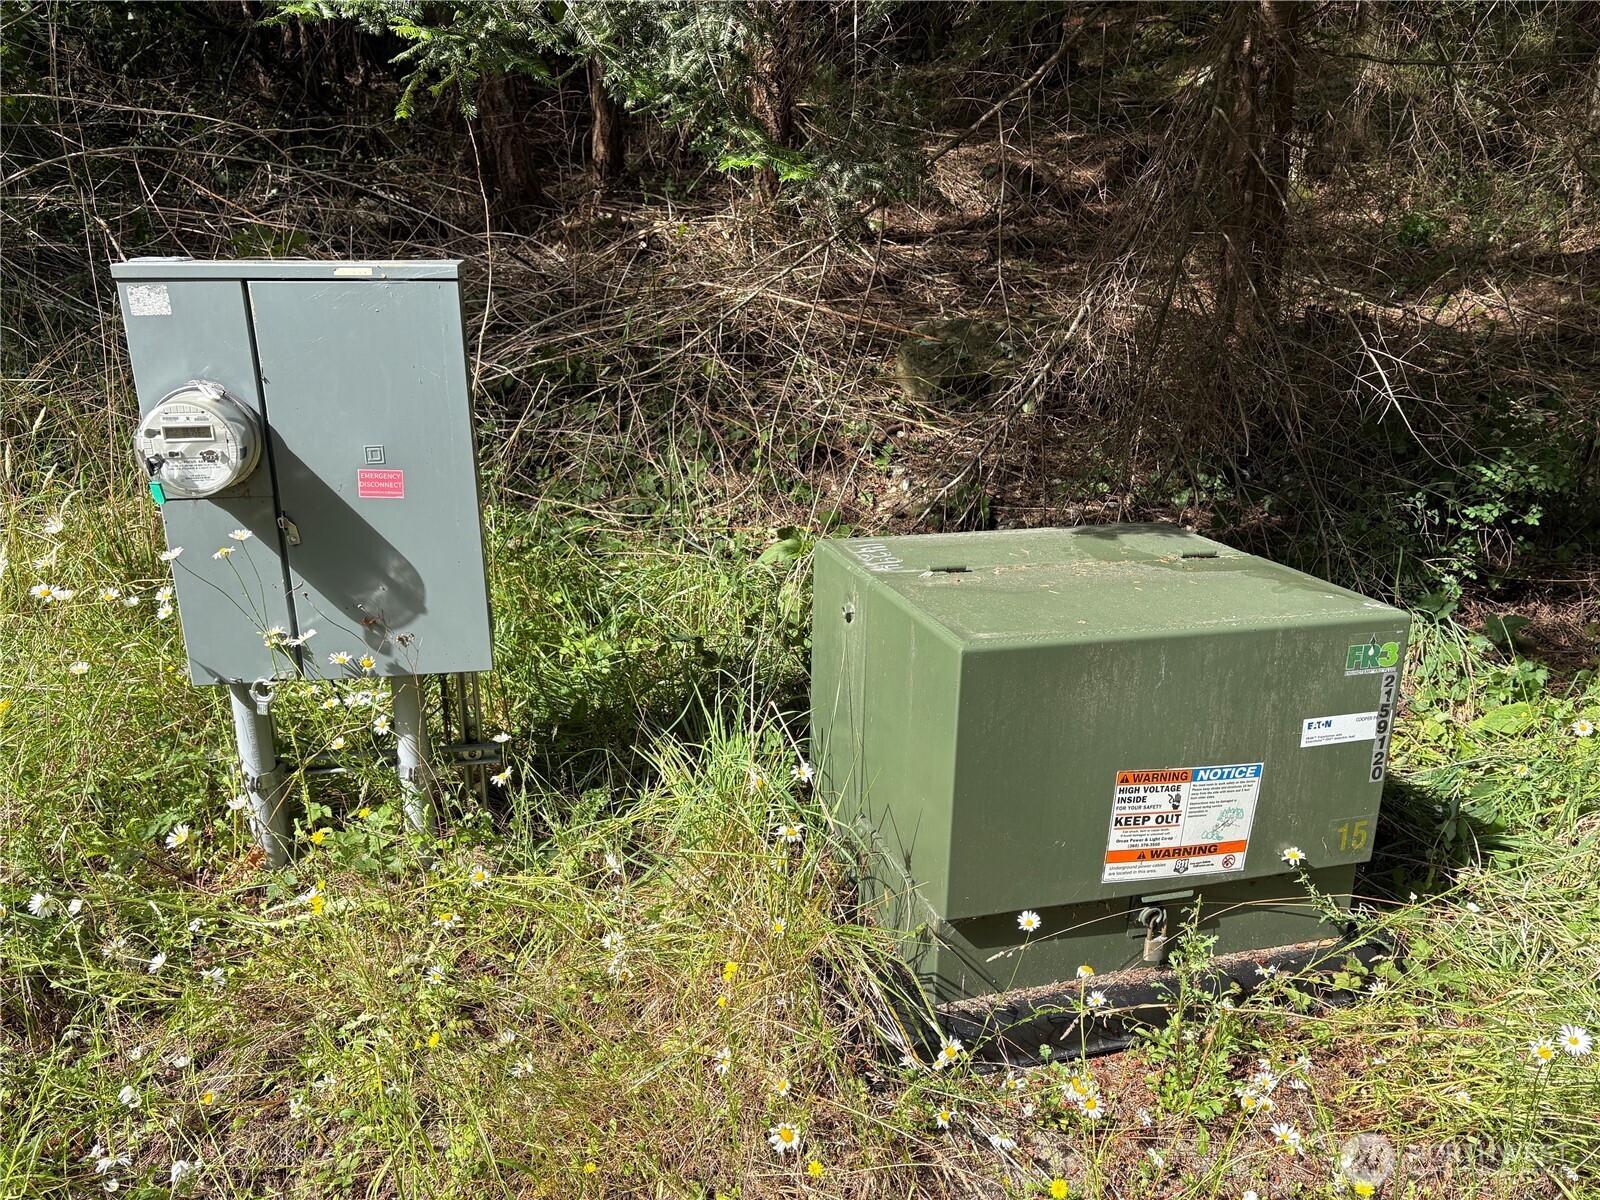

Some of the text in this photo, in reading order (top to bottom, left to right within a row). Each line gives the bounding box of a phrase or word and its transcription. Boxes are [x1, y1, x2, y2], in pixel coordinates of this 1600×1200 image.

[360, 472, 401, 480] EMERGENCY
[359, 481, 402, 489] DISCONNECT
[1346, 641, 1399, 670] FR3
[1370, 674, 1396, 781] 2159120
[1132, 772, 1188, 783] WARNING
[1197, 767, 1257, 781] NOTICE
[1118, 784, 1182, 795] HIGH VOLTAGE
[1117, 795, 1148, 804] INSIDE
[1114, 813, 1182, 827] KEEP OUT
[1337, 821, 1369, 851] 15
[1150, 845, 1218, 858] WARNING
[1108, 864, 1137, 873] Underground
[1175, 859, 1189, 868] 811
